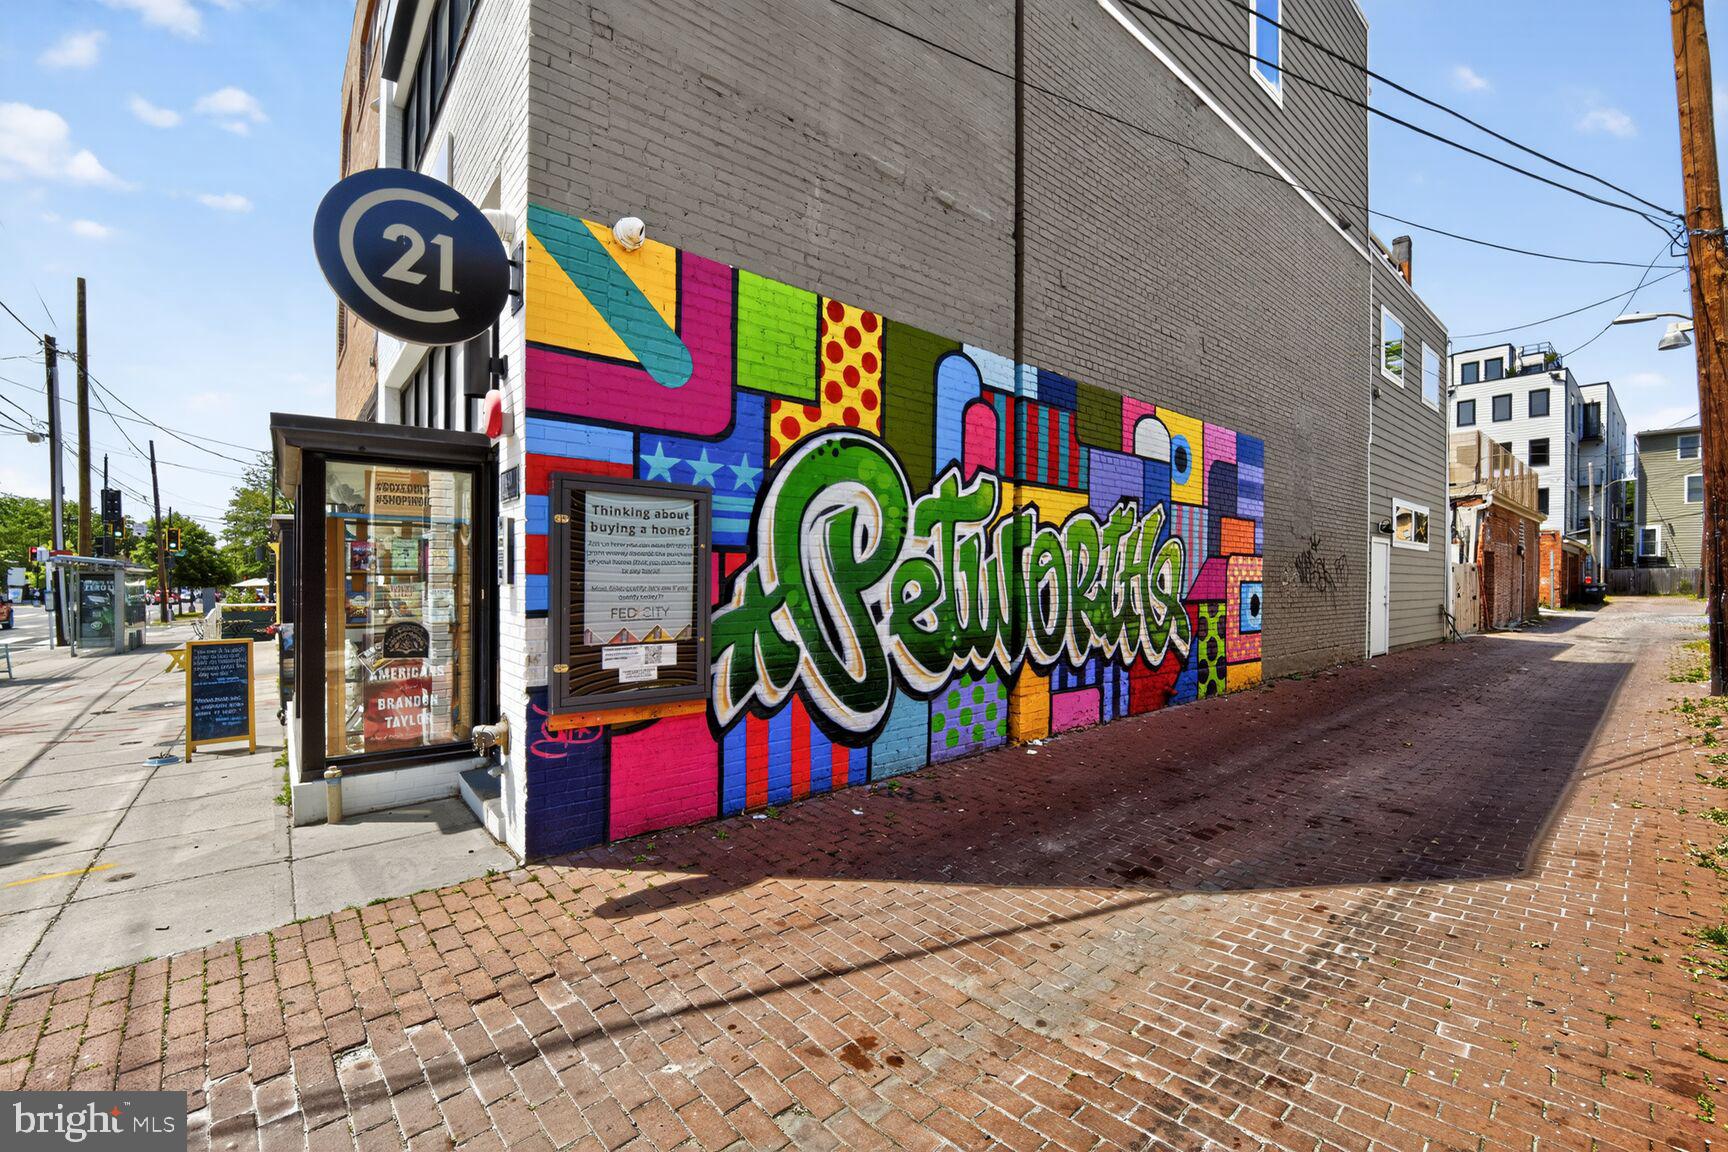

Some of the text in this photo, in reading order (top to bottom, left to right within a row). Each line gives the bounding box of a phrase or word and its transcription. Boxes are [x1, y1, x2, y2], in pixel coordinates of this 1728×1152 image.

[592, 505, 690, 520] Thinking about
[590, 521, 691, 536] buying a home?
[610, 605, 670, 619] FED CITY
